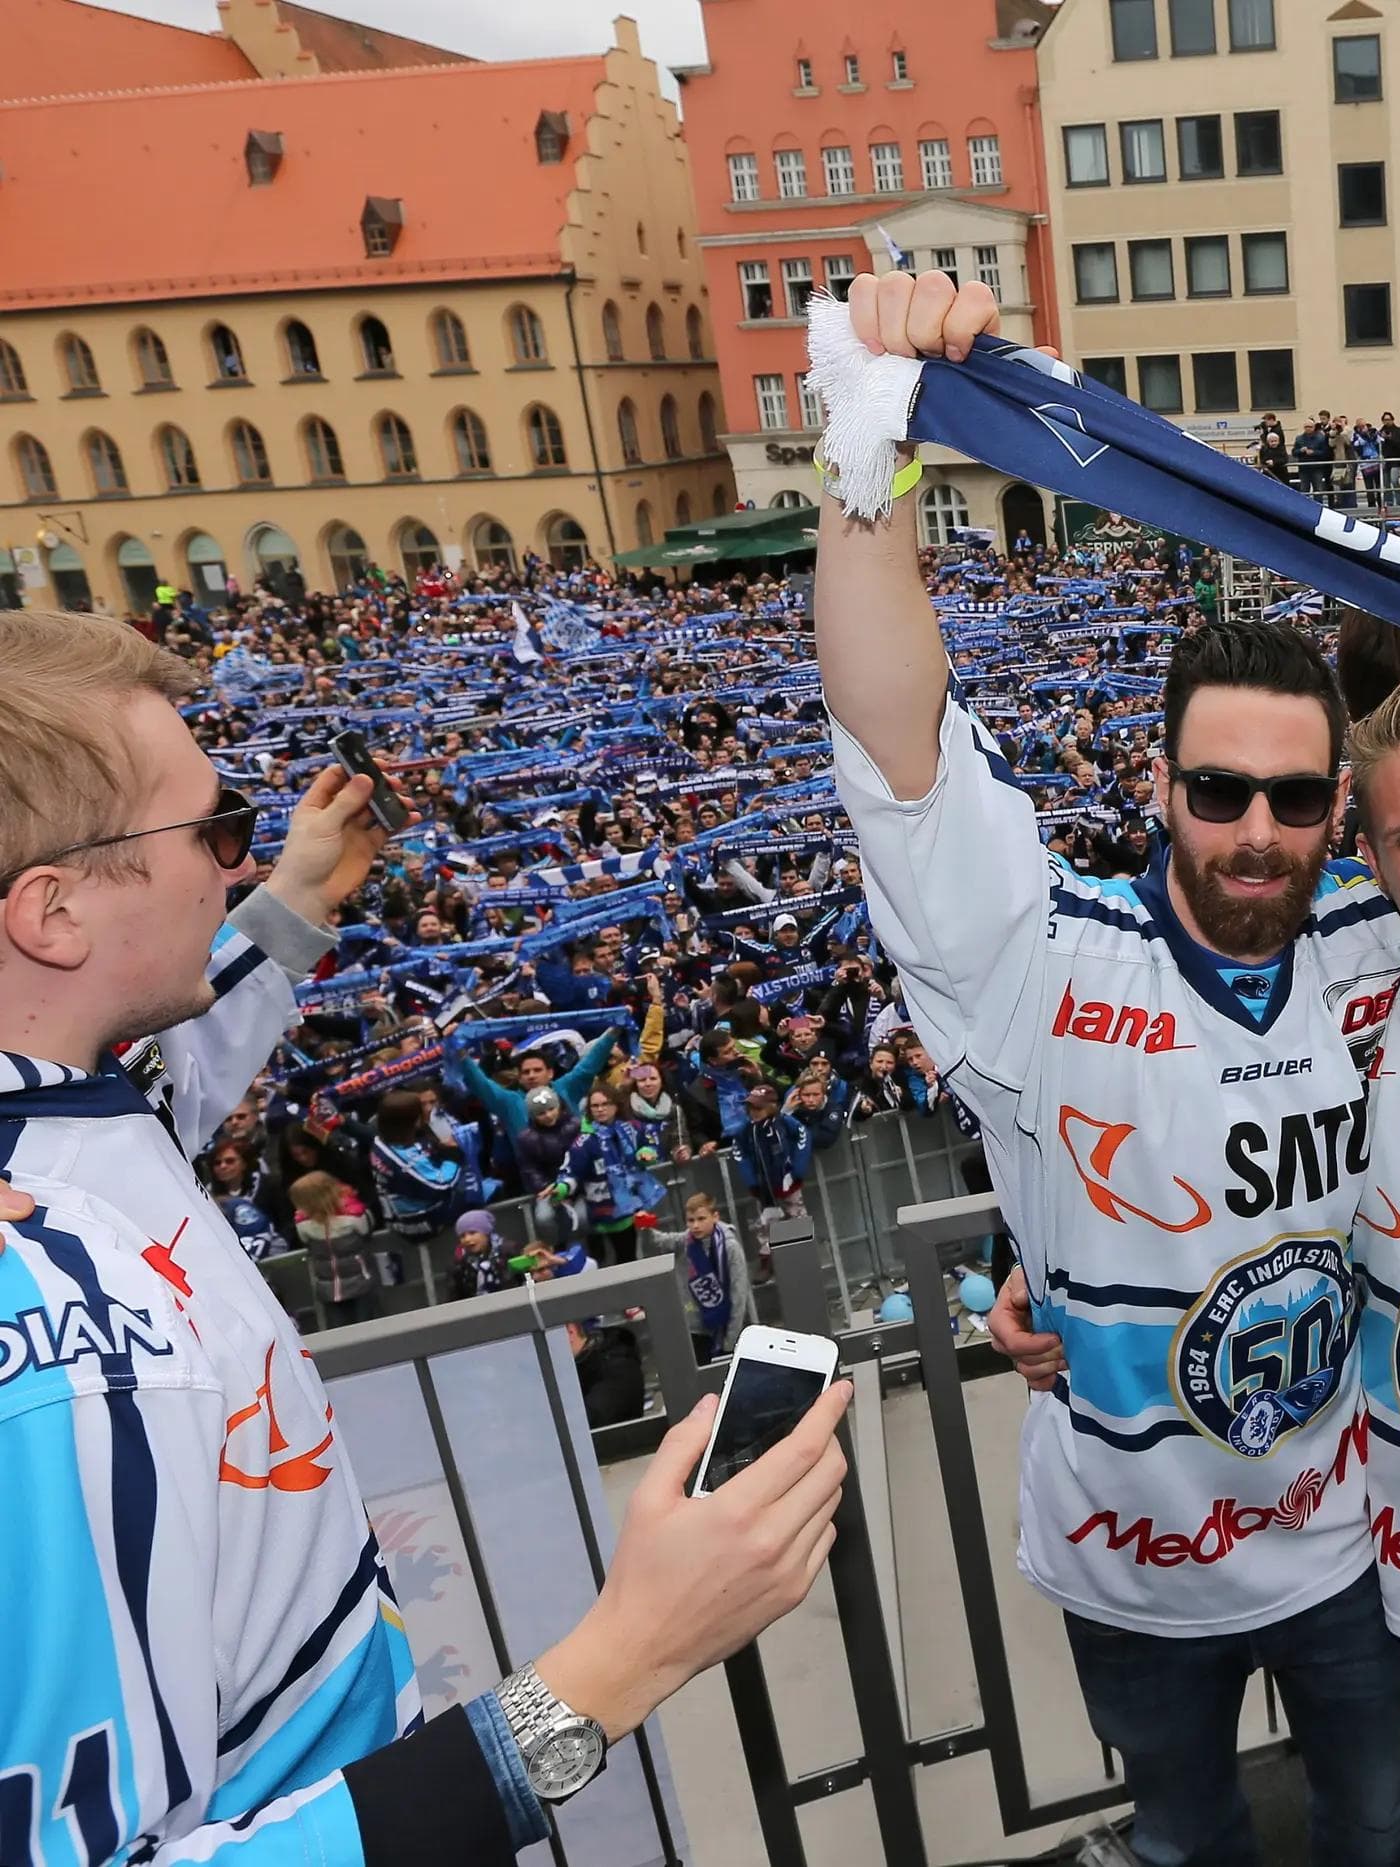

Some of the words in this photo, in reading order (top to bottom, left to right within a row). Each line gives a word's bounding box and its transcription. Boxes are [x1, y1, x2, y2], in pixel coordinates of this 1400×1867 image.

[766, 443, 815, 465] Spa
[754, 970, 823, 998] INGOLSTA
[1342, 988, 1396, 1036] DE
[1225, 1085, 1370, 1219] SATU
[1208, 1279, 1245, 1325] ERC
[1188, 1348, 1214, 1404] 1964
[1229, 1296, 1335, 1415] 50
[1066, 1498, 1277, 1568] Media
